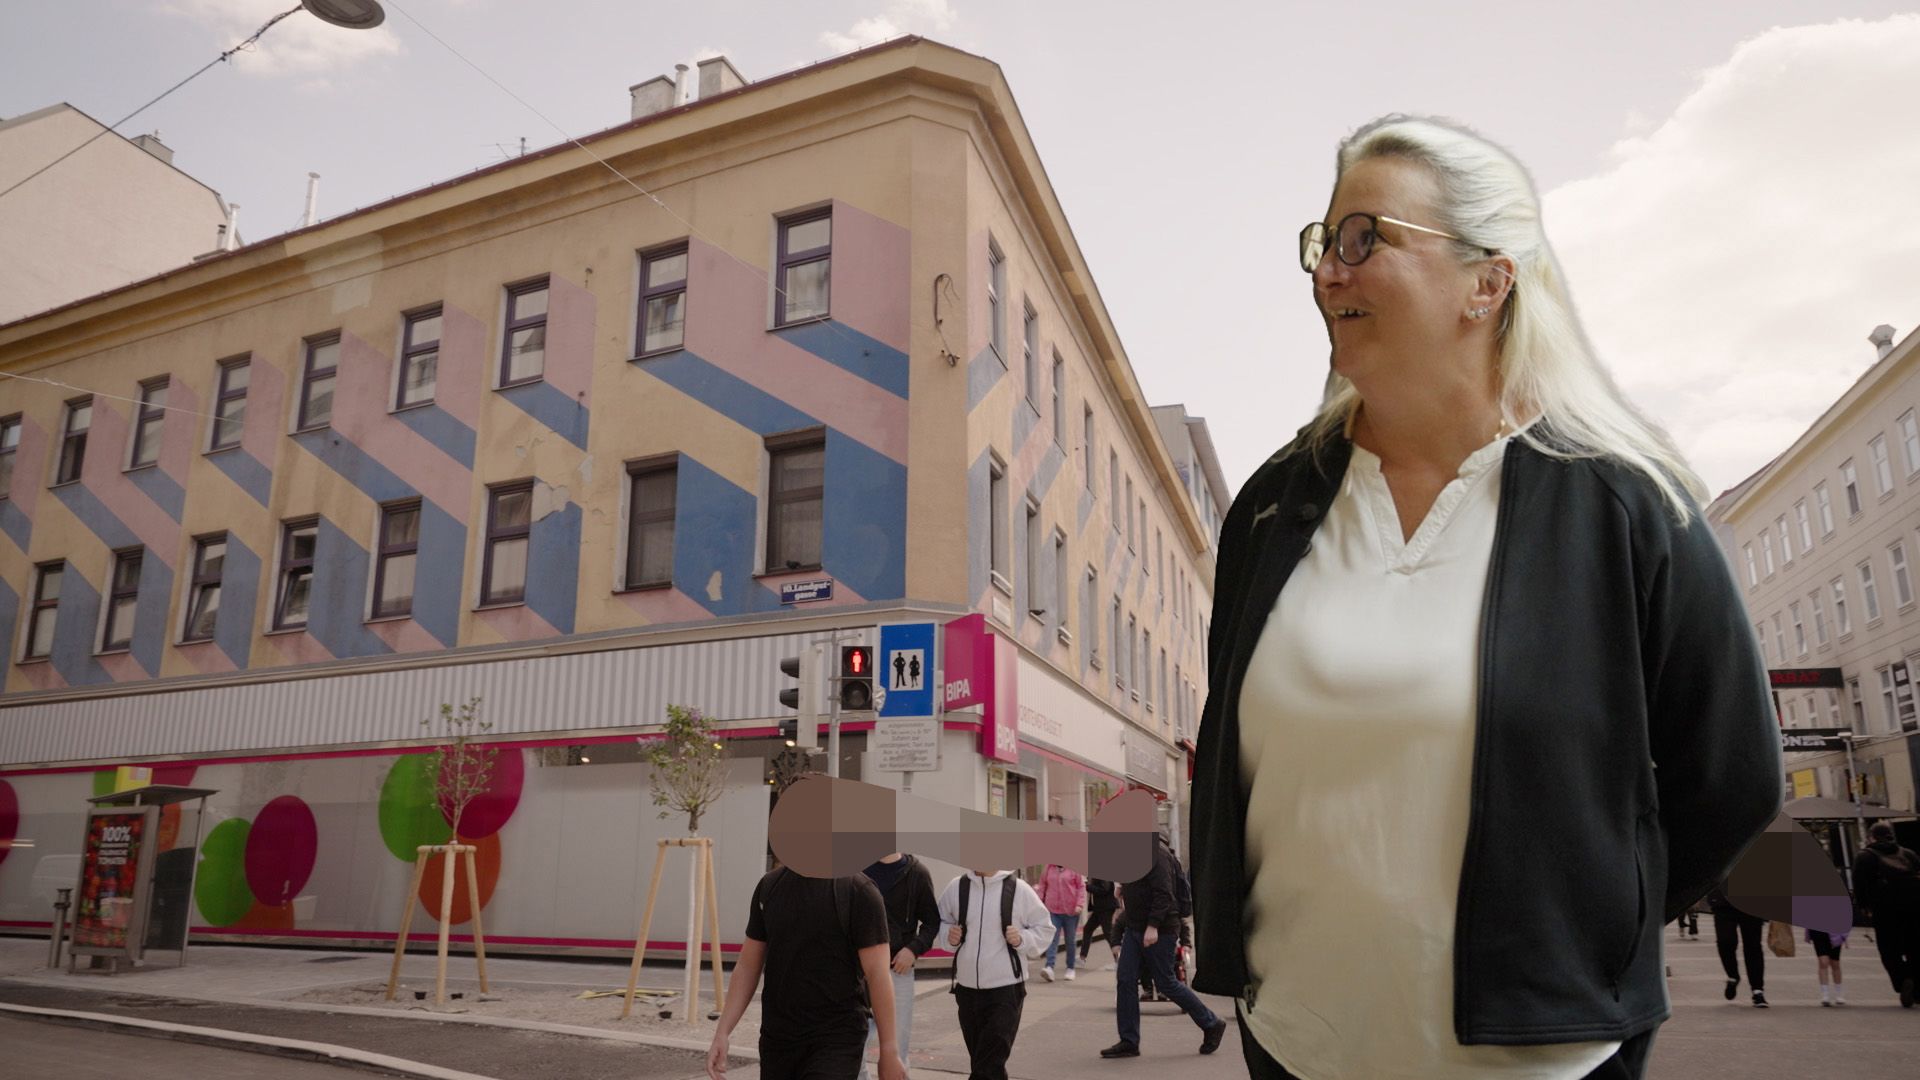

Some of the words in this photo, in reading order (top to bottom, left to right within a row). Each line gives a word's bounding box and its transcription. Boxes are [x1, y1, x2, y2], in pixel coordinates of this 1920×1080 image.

[794, 591, 818, 601] gasse
[946, 678, 971, 702] BIPA
[997, 723, 1017, 754] BIPA
[1781, 733, 1827, 747] ÖNER
[102, 826, 132, 842] 100%
